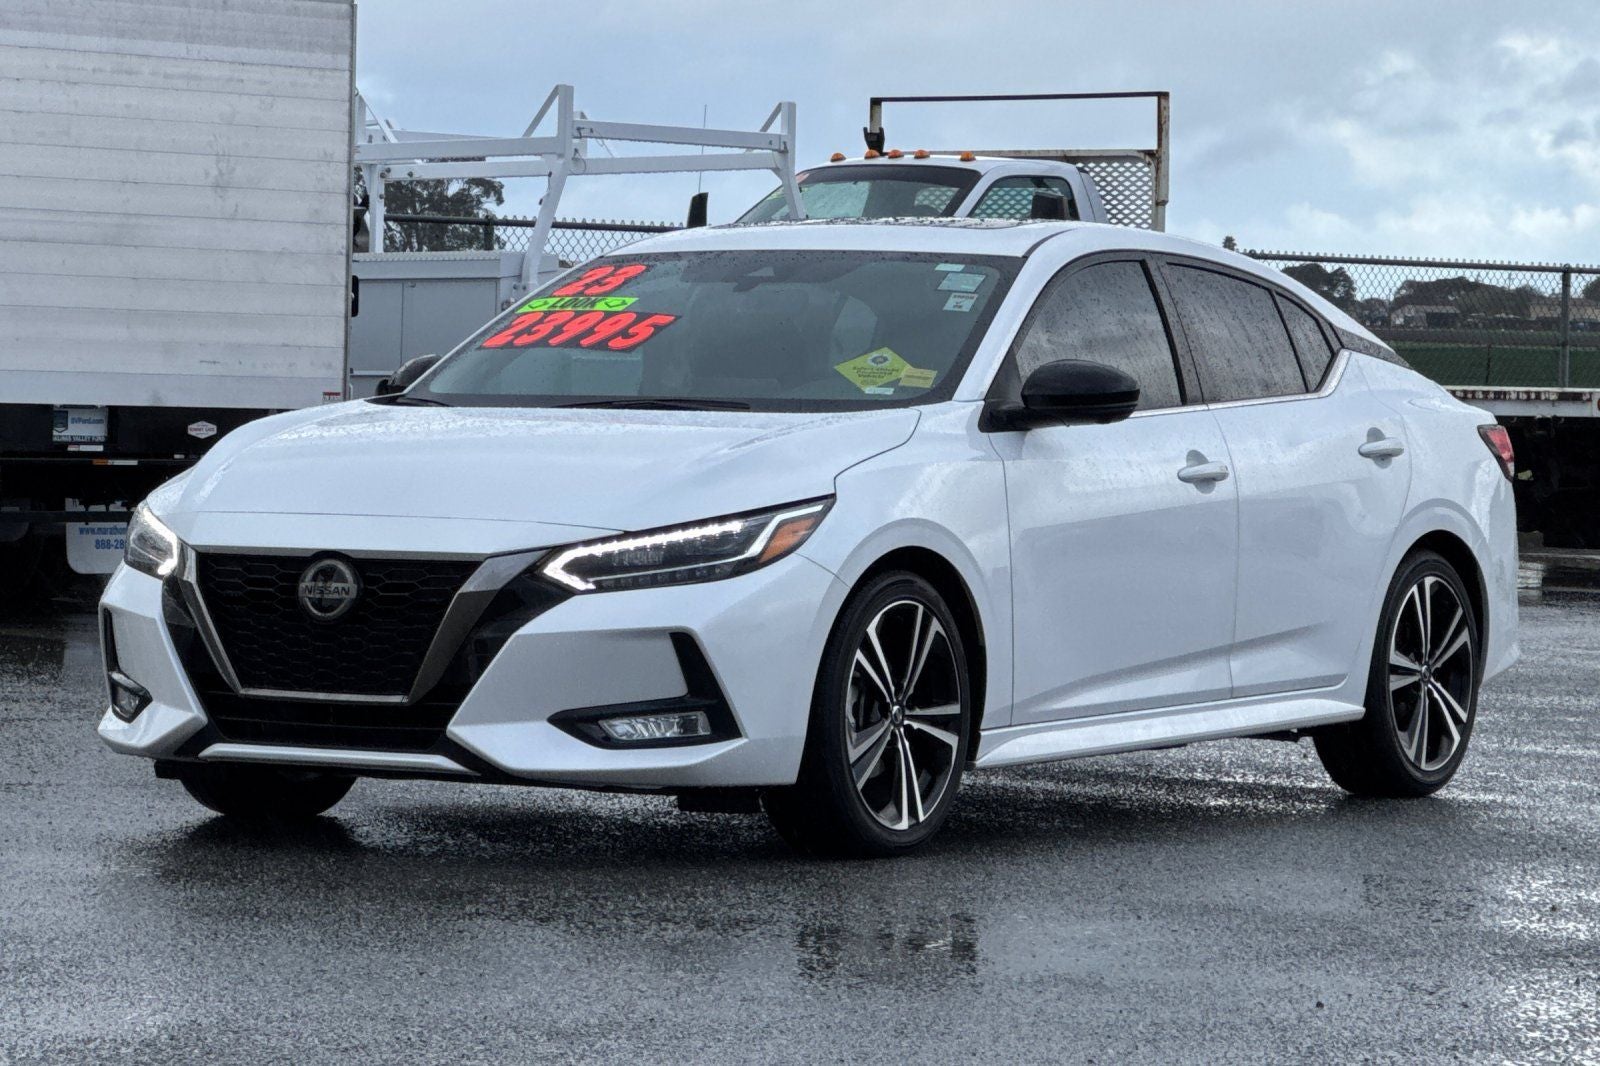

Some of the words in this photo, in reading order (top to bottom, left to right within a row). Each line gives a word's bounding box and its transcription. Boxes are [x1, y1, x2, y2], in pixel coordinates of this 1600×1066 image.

[552, 264, 648, 297] 23
[547, 297, 604, 309] LOOK
[481, 311, 677, 350] 23995
[304, 584, 350, 596] NISSAN
